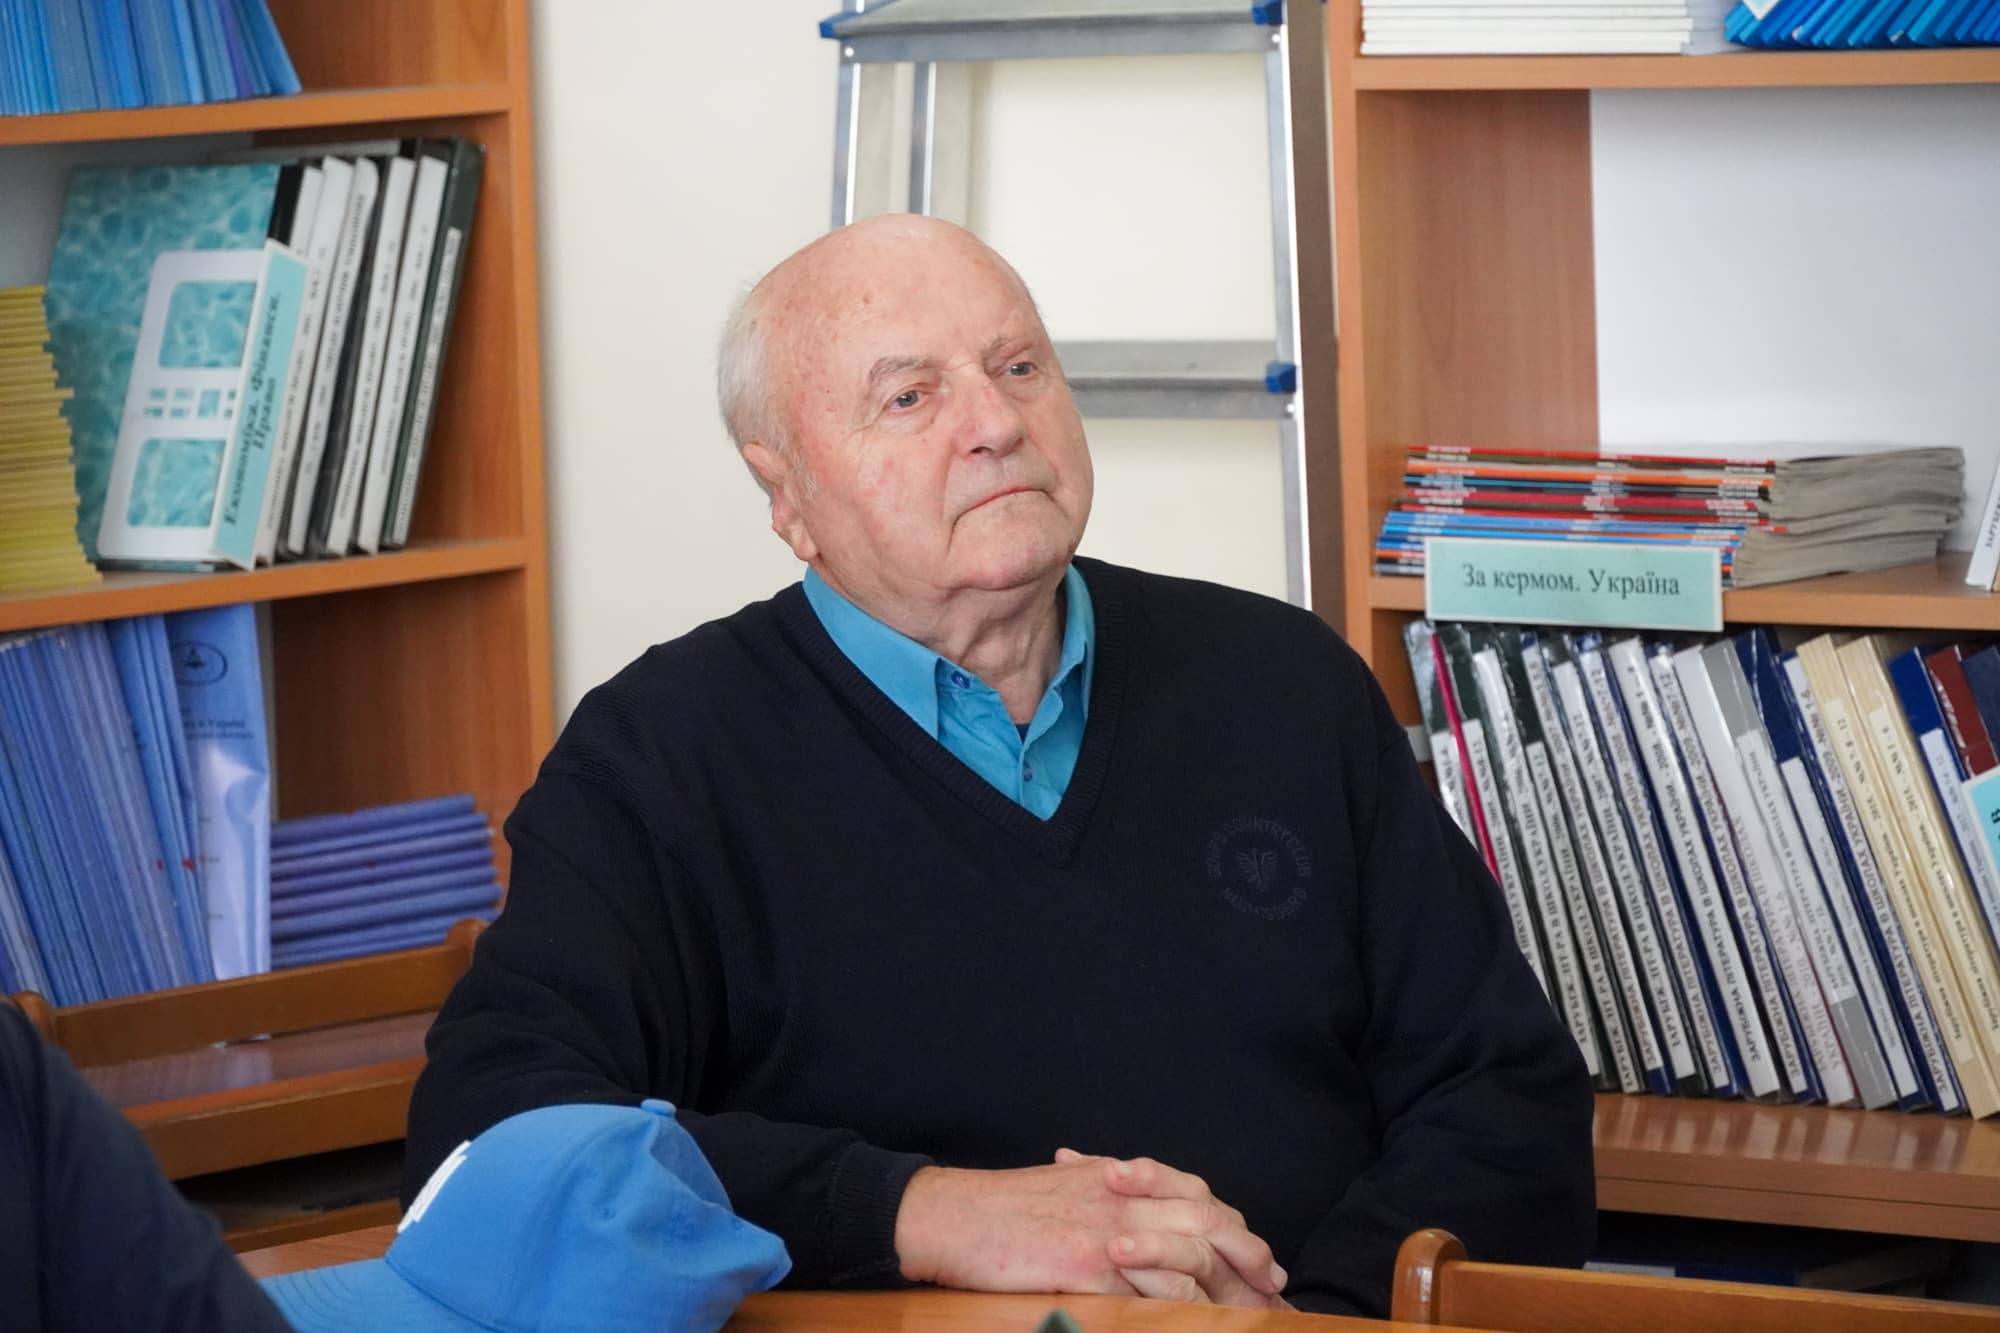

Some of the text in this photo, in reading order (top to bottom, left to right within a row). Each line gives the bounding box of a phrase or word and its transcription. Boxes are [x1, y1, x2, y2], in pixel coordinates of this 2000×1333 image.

[1462, 562, 1680, 599] За кермом. Україна
